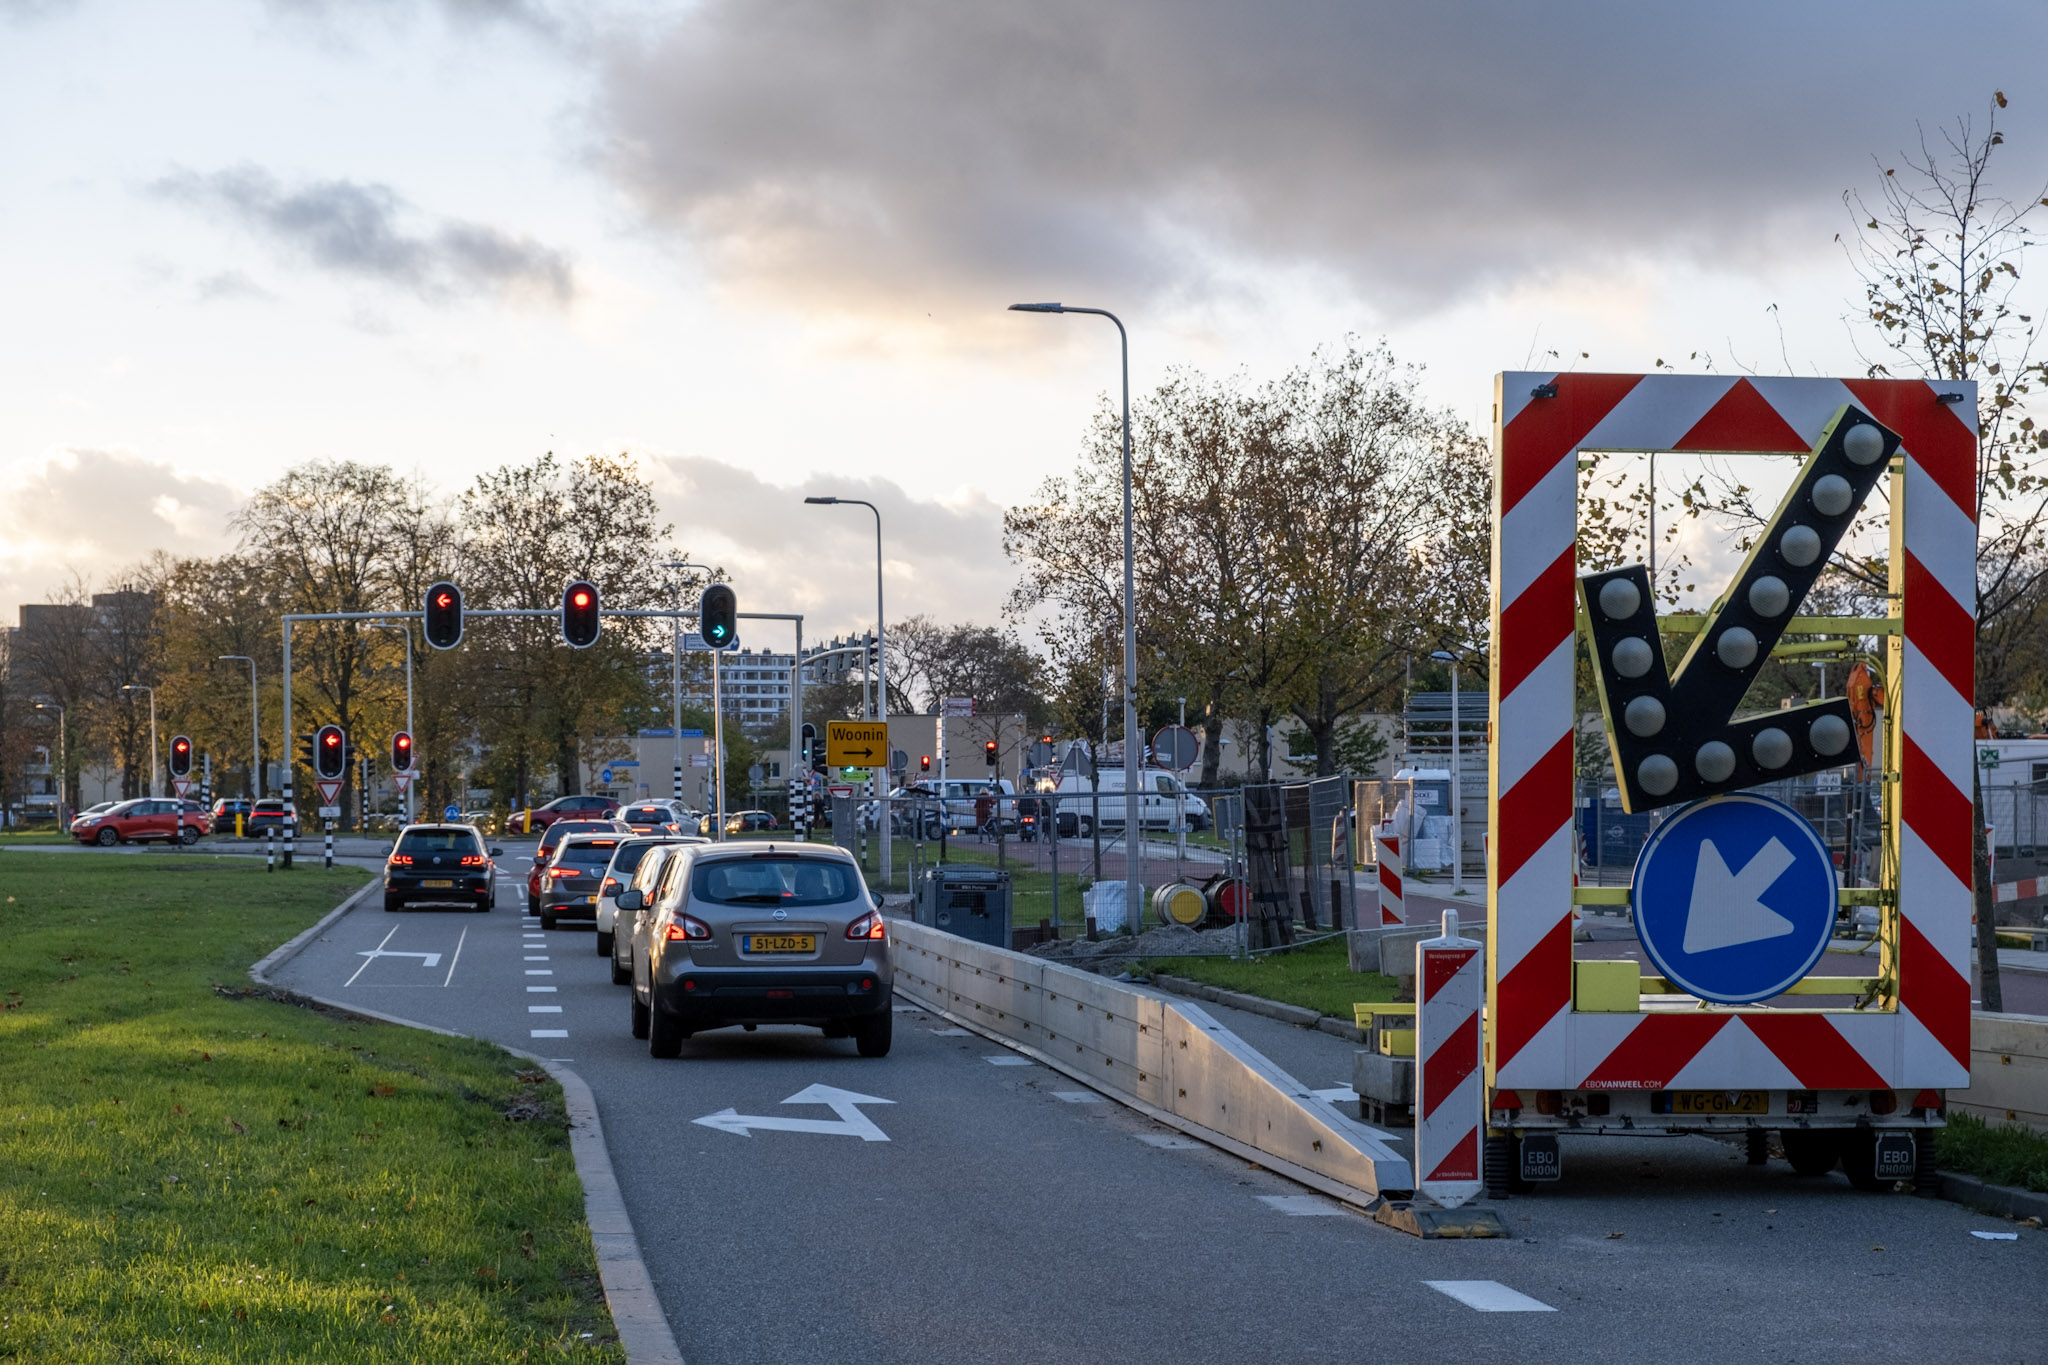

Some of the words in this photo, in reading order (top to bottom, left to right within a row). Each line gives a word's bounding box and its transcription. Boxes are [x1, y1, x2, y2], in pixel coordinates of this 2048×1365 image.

[832, 727, 884, 741] Woonin
[756, 938, 808, 949] 51-LZD-5
[1585, 1080, 1662, 1089] EBOVANWEEL.COM
[1681, 1093, 1760, 1111] WG-G21
[1528, 1151, 1554, 1164] EBO
[1883, 1151, 1909, 1164] EBO
[1524, 1165, 1558, 1176] RHOON
[1880, 1164, 1912, 1175] RHOON
